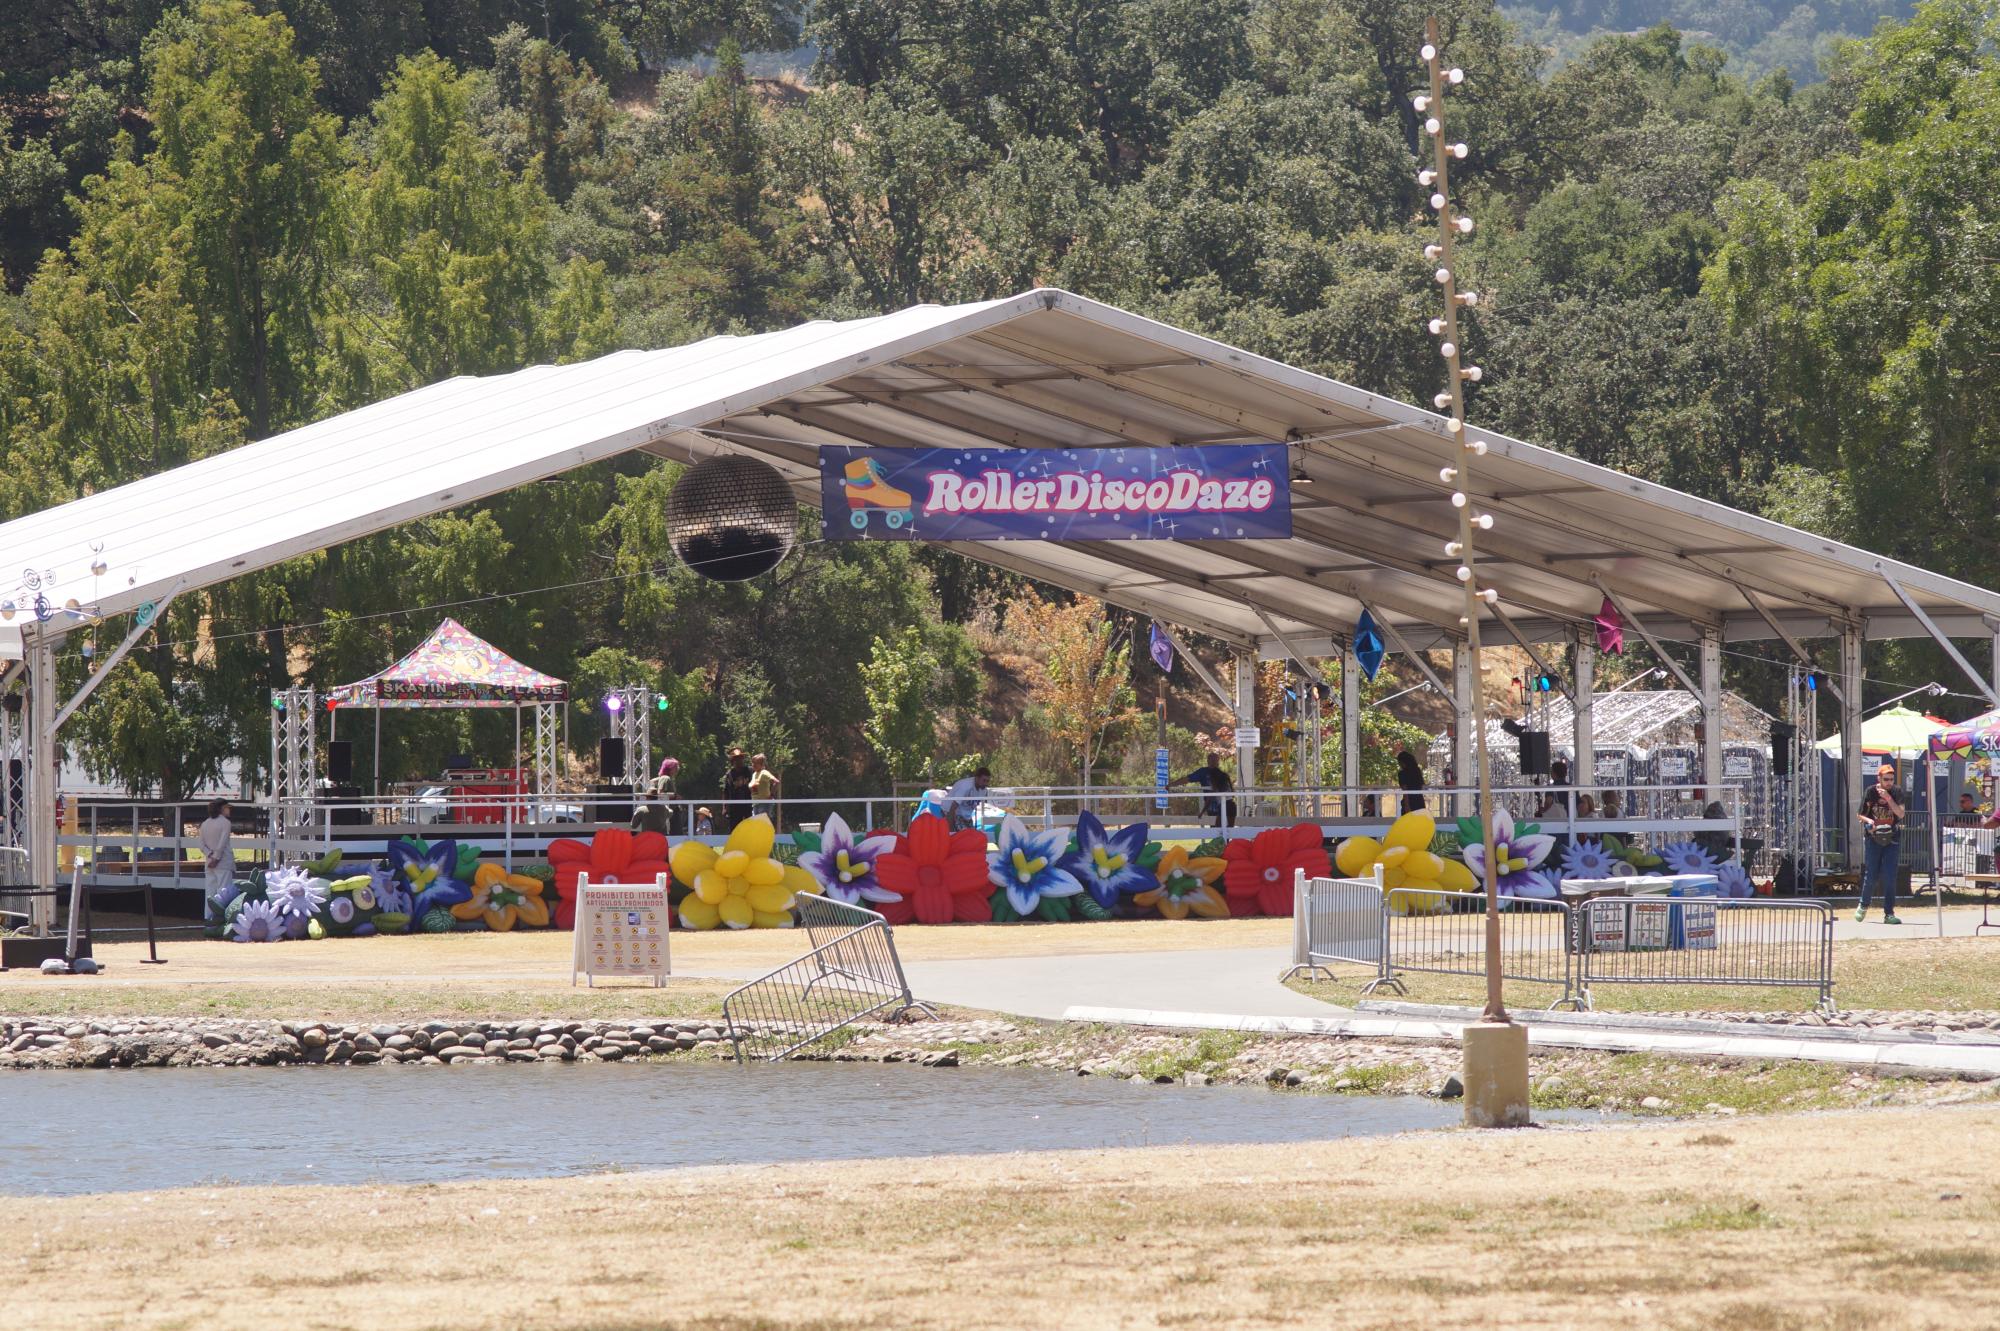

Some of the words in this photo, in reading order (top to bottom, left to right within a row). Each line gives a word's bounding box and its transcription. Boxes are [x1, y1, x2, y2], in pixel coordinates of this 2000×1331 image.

[925, 470, 1275, 514] RollerDiscoDaze
[503, 685, 563, 695] PLACE
[1982, 735, 2000, 751] SK
